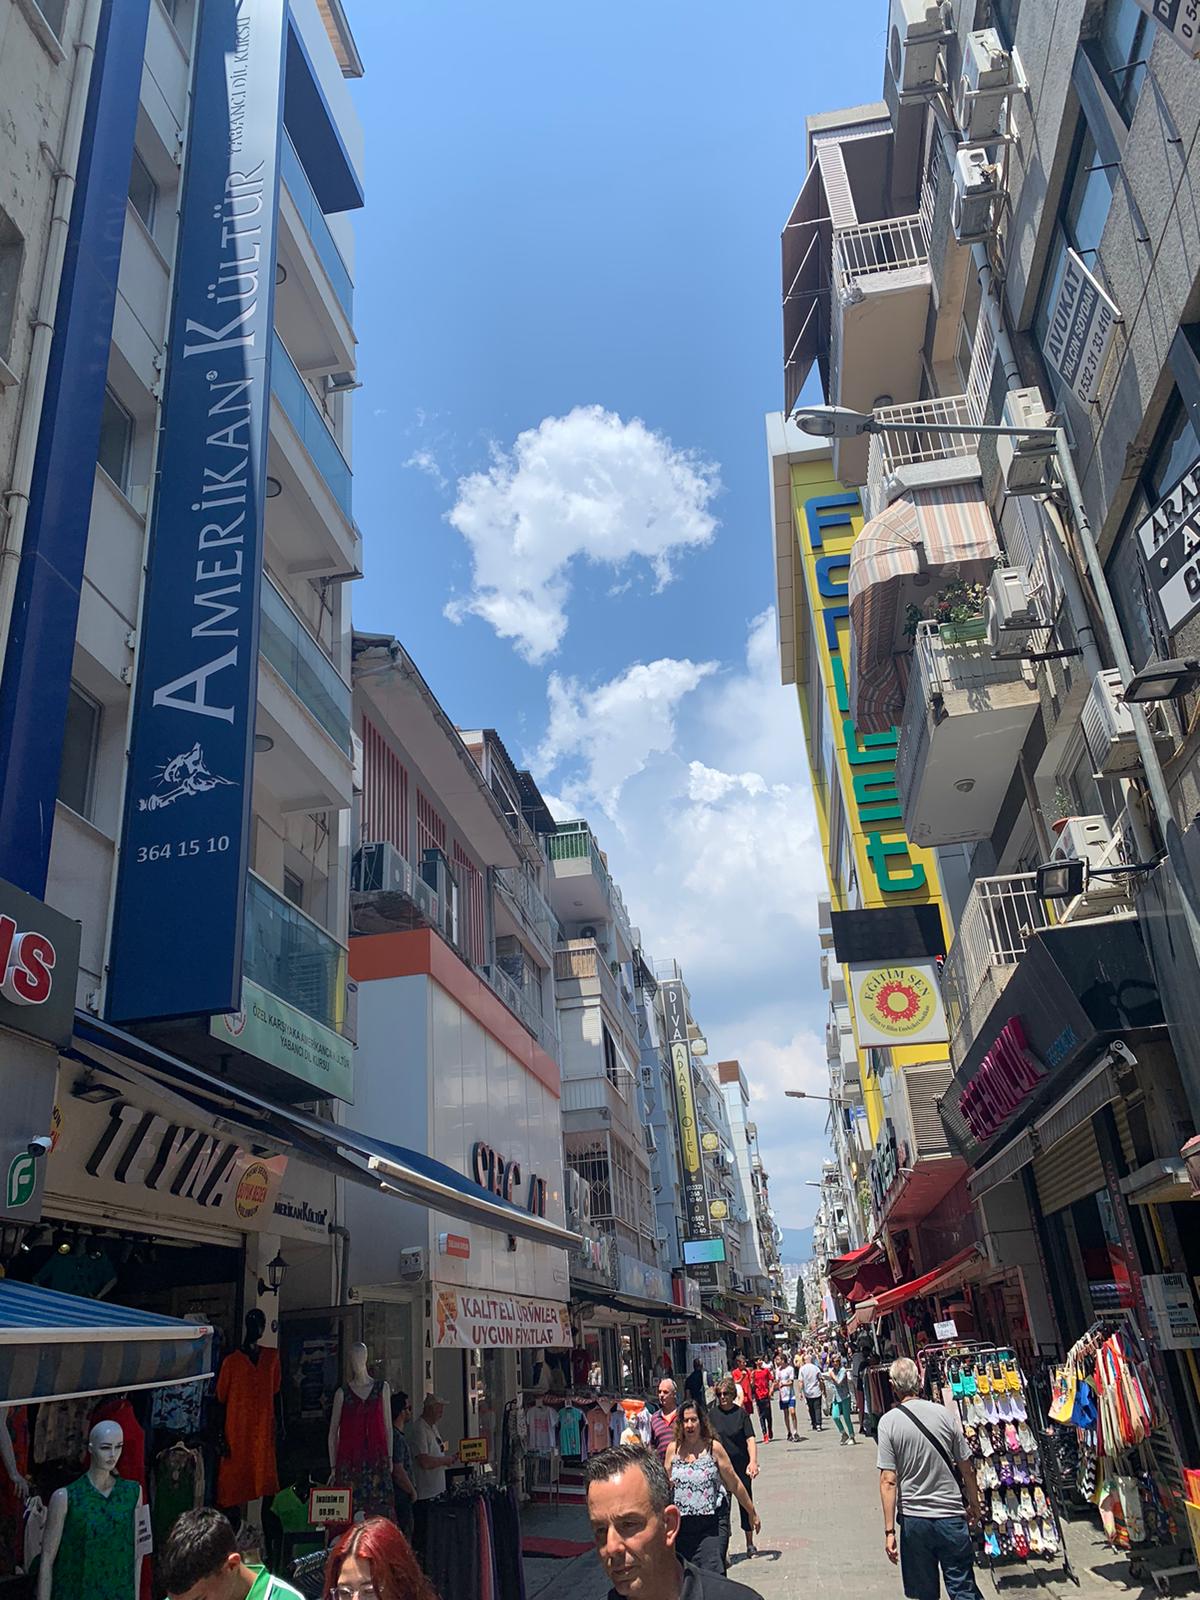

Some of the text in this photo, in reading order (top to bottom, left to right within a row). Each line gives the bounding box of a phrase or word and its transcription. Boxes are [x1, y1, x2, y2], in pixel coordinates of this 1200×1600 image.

[1048, 262, 1080, 363] AVUKAT
[1063, 284, 1095, 380] YALÇIN SOYDAN
[1078, 306, 1112, 402] 0 532 31 33 410
[153, 160, 265, 725] AMERİKAN KÜLTÜR
[137, 835, 230, 864] 364 15 10
[865, 968, 929, 1001] EĞİTİM SEN
[252, 1003, 268, 1024] ÖZEL
[669, 991, 683, 1040] DIVA
[461, 1294, 559, 1324] KALİTELİ ÜRÜNLER
[472, 1325, 513, 1345] UYGUN
